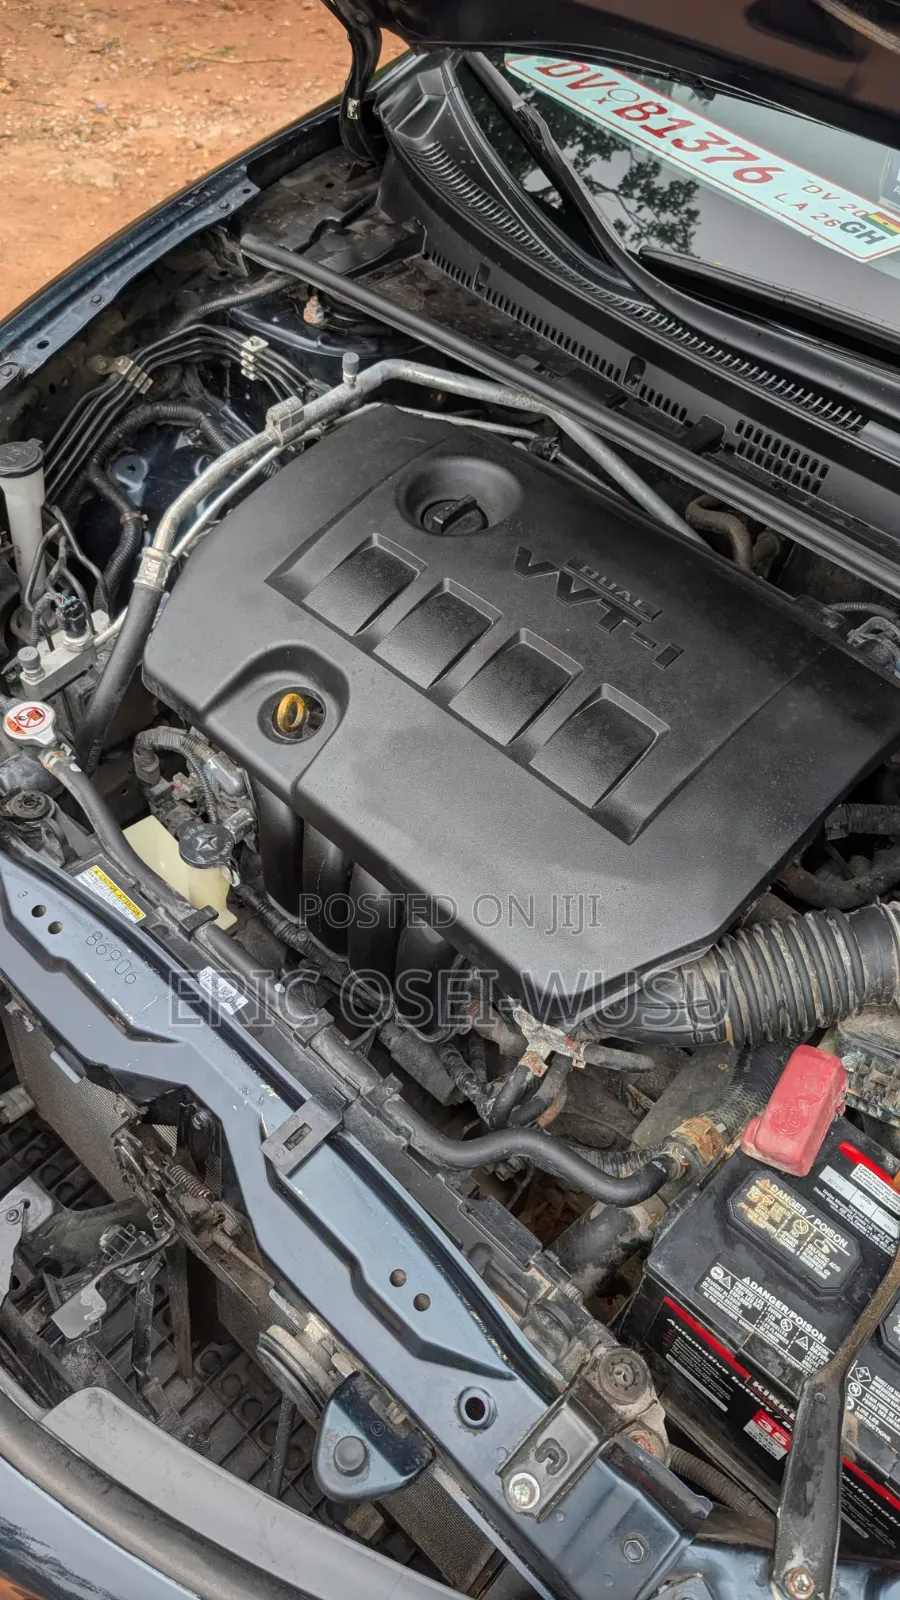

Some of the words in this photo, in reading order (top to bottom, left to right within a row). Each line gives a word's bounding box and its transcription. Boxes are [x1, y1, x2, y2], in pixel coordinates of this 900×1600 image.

[535, 60, 621, 91] DV
[611, 100, 786, 184] B1376
[801, 184, 841, 201] DV
[838, 203, 870, 218] 20
[809, 212, 841, 228] 26
[839, 221, 888, 245] GH
[578, 564, 648, 613] DUAL
[85, 930, 143, 985] 86906
[768, 1183, 808, 1216] DANGER
[812, 1217, 849, 1248] POISON
[748, 1280, 827, 1343] DANGER/POISON
[666, 1318, 729, 1375] Automotive
[755, 1416, 789, 1446] 35
